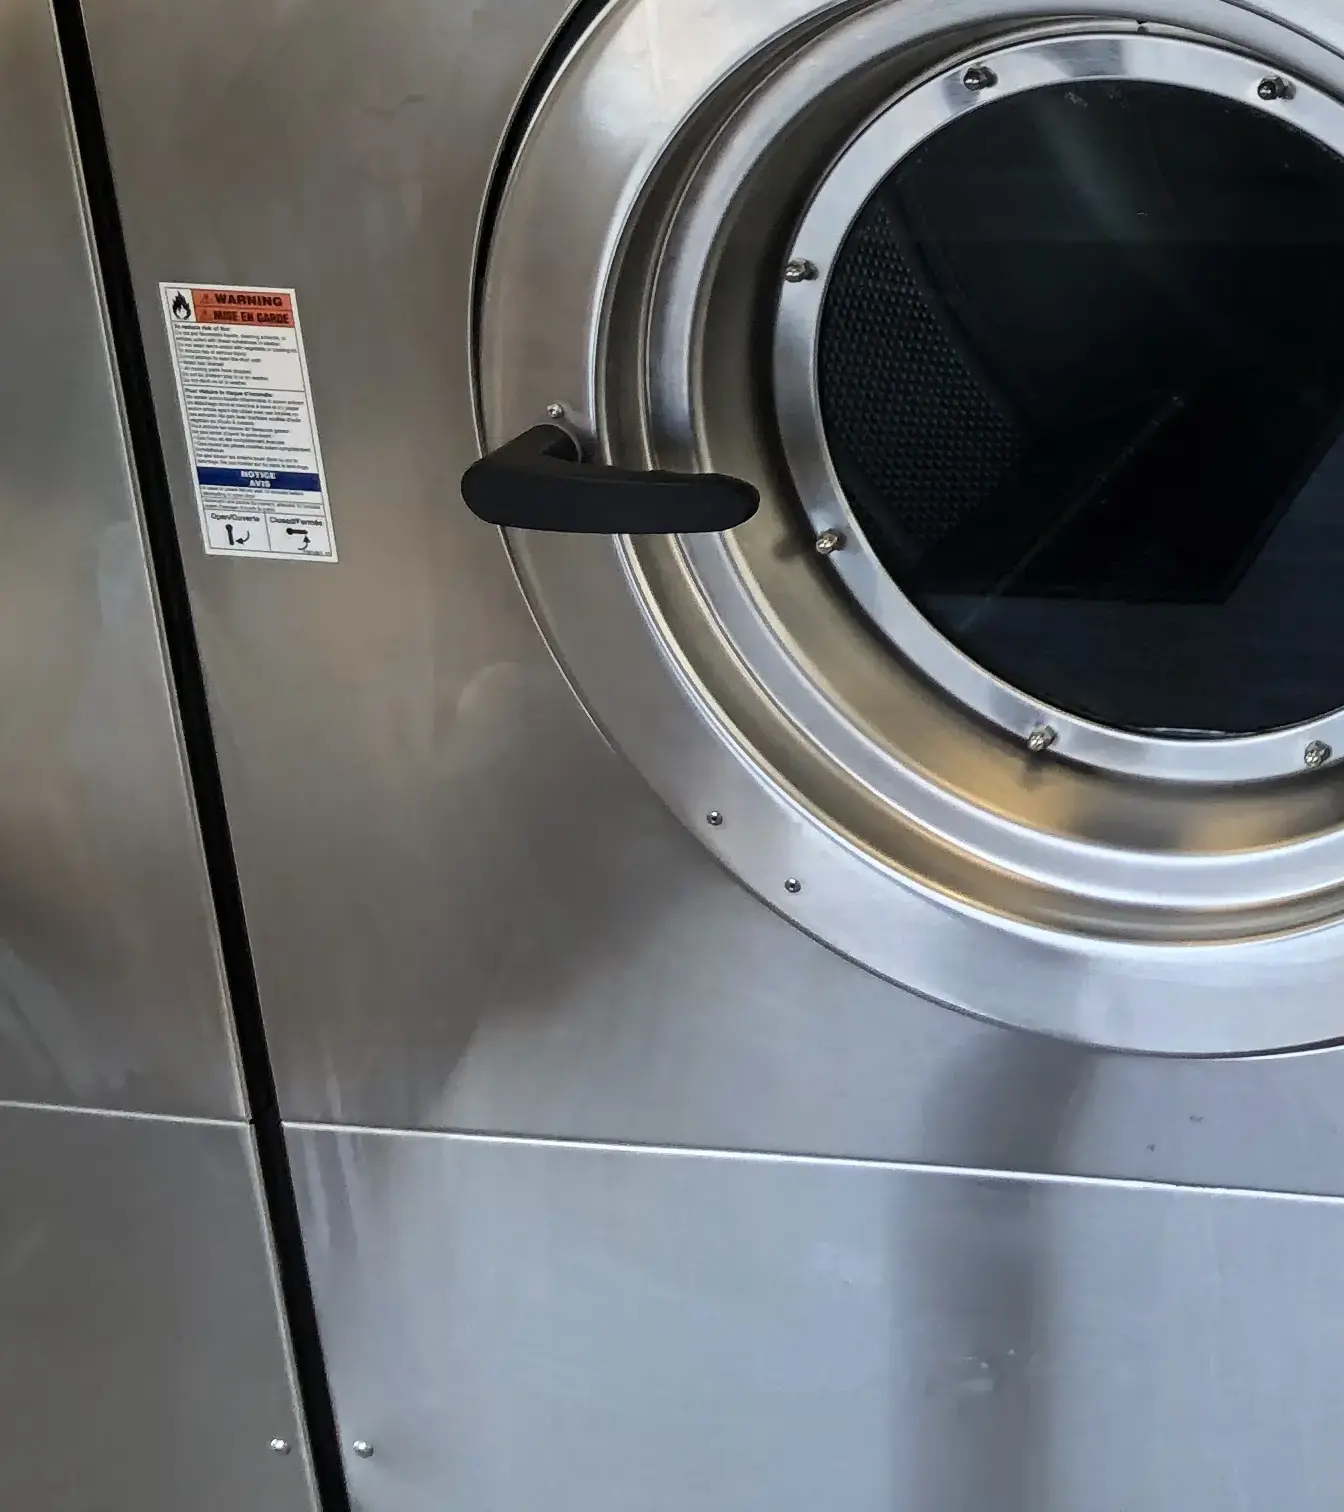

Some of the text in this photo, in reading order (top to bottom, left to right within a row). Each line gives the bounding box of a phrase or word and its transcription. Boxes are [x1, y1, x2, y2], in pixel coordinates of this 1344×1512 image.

[214, 293, 283, 307] WARNING
[240, 312, 254, 322] EN
[257, 313, 289, 324] GARDE
[240, 471, 276, 480] NOTICE
